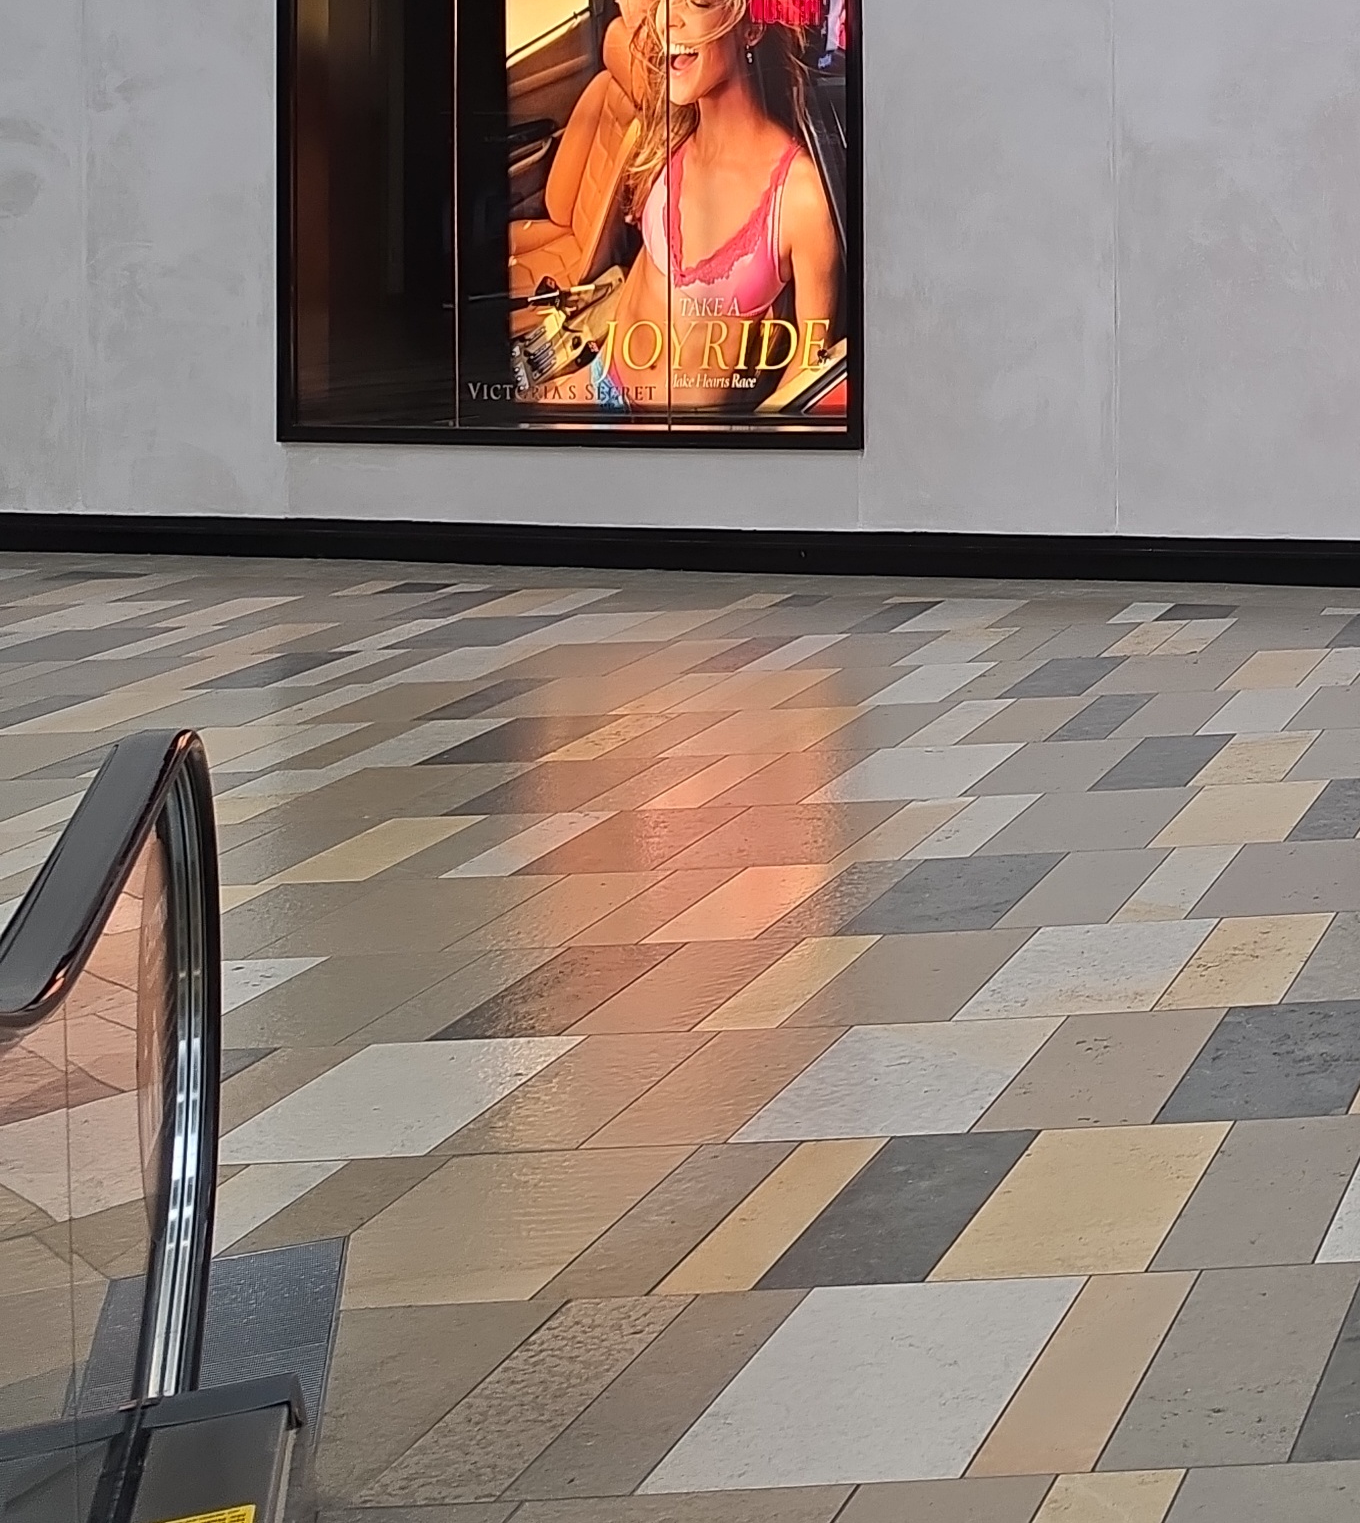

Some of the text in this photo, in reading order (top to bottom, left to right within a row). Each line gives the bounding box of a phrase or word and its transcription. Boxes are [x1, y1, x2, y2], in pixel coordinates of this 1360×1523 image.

[680, 297, 741, 317] TAKE A
[601, 319, 830, 379] JOYRIDE
[730, 372, 756, 388] Race
[467, 381, 577, 401] VICTORIAS
